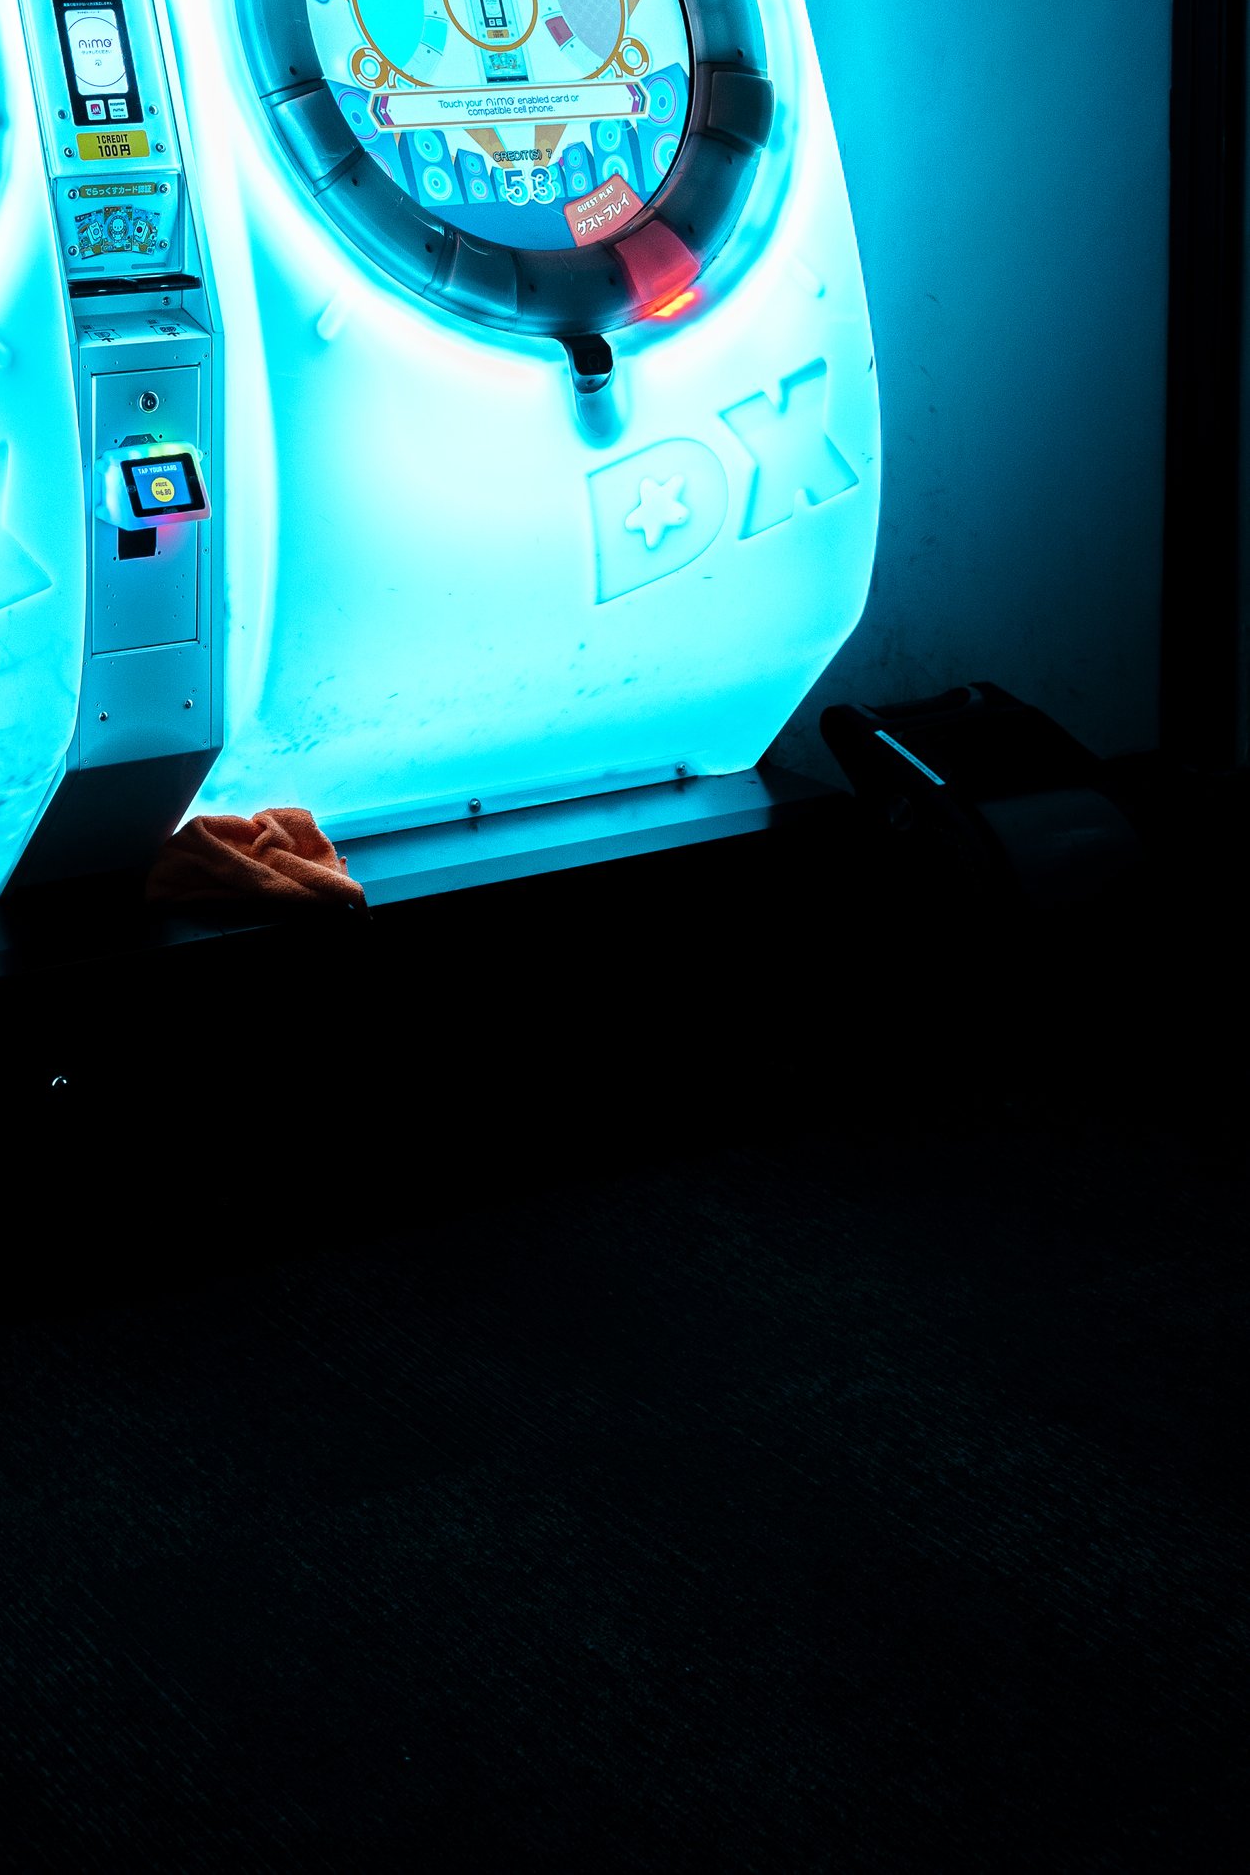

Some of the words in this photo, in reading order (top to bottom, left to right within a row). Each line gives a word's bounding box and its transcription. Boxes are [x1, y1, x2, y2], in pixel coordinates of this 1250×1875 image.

[438, 99, 464, 109] Touch
[464, 99, 483, 110] your
[517, 95, 549, 105] enabled
[550, 95, 570, 103] card
[571, 94, 580, 102] or
[468, 104, 512, 117] compatible
[513, 104, 527, 114] cell
[528, 103, 556, 114] phone.
[492, 148, 542, 162] CREDIT(S)
[545, 148, 553, 159] 7
[503, 166, 556, 206] 53
[577, 196, 599, 214] GUEST
[598, 185, 615, 200] PLAY
[576, 192, 631, 236] ゲストプレイ
[149, 466, 163, 474] YOUR
[586, 357, 860, 606] DX
